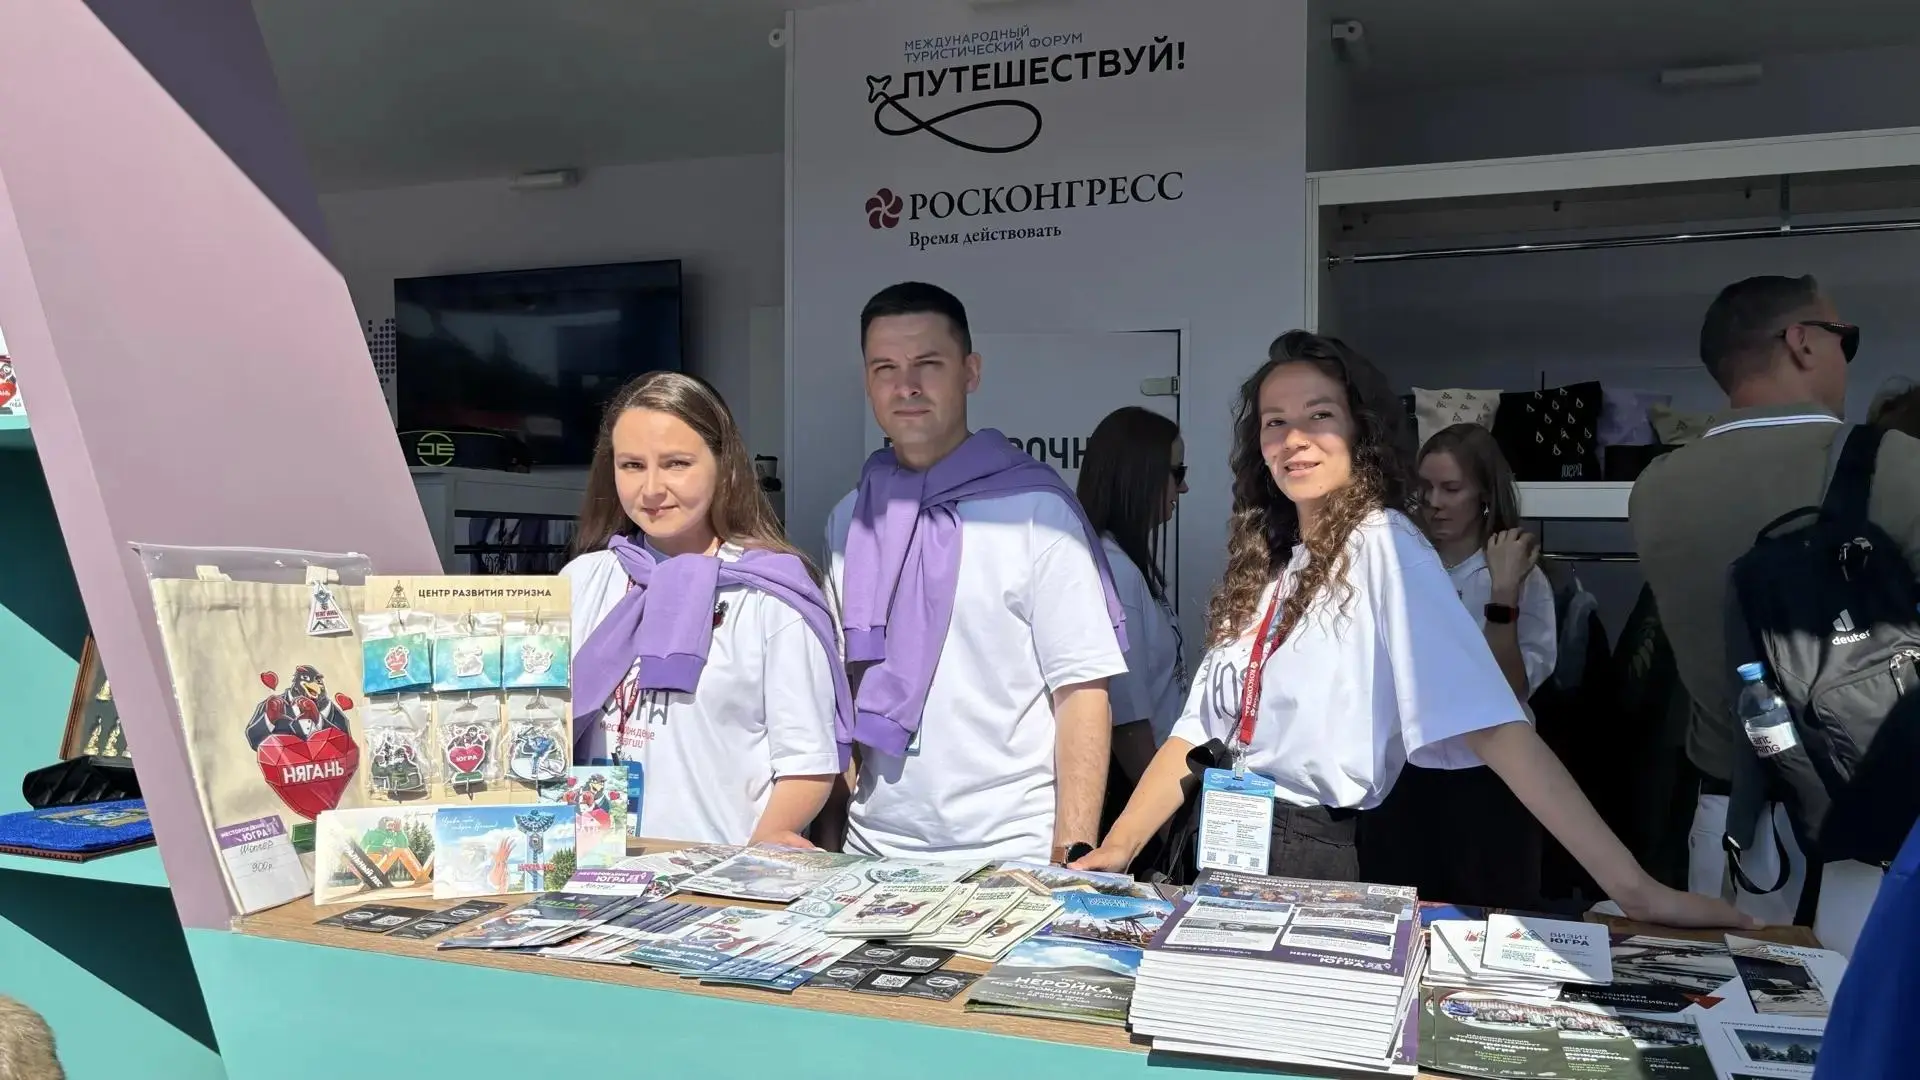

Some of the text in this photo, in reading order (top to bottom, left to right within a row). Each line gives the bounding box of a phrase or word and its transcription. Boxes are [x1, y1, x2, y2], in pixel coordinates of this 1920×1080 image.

[904, 24, 1030, 51] МЕЖДУНАРОДНЫЙ
[904, 32, 1083, 64] ТУРИСТИЧЕСКИЙ ФОРУМ
[903, 35, 1186, 98] ПУТЕШЕСТВУЙ!
[909, 171, 1184, 221] РОСКОНГРЕСС
[909, 224, 1062, 251] Время действовать
[418, 589, 552, 598] ЦЕНТР РАЗВИТИЯ ТУРИЗМА
[1832, 629, 1870, 646] deuter
[456, 754, 478, 763] ЮГРА
[282, 760, 345, 784] НЯГАНЬ
[242, 828, 269, 842] ЮГРА
[595, 875, 625, 883] ЮГРА
[1550, 937, 1590, 947] ЮГРА
[1319, 957, 1365, 969] ЮГРА
[990, 981, 1091, 997] МЕСТОРОЖДЕНИЕ
[1015, 976, 1113, 995] НЕРОЙКА
